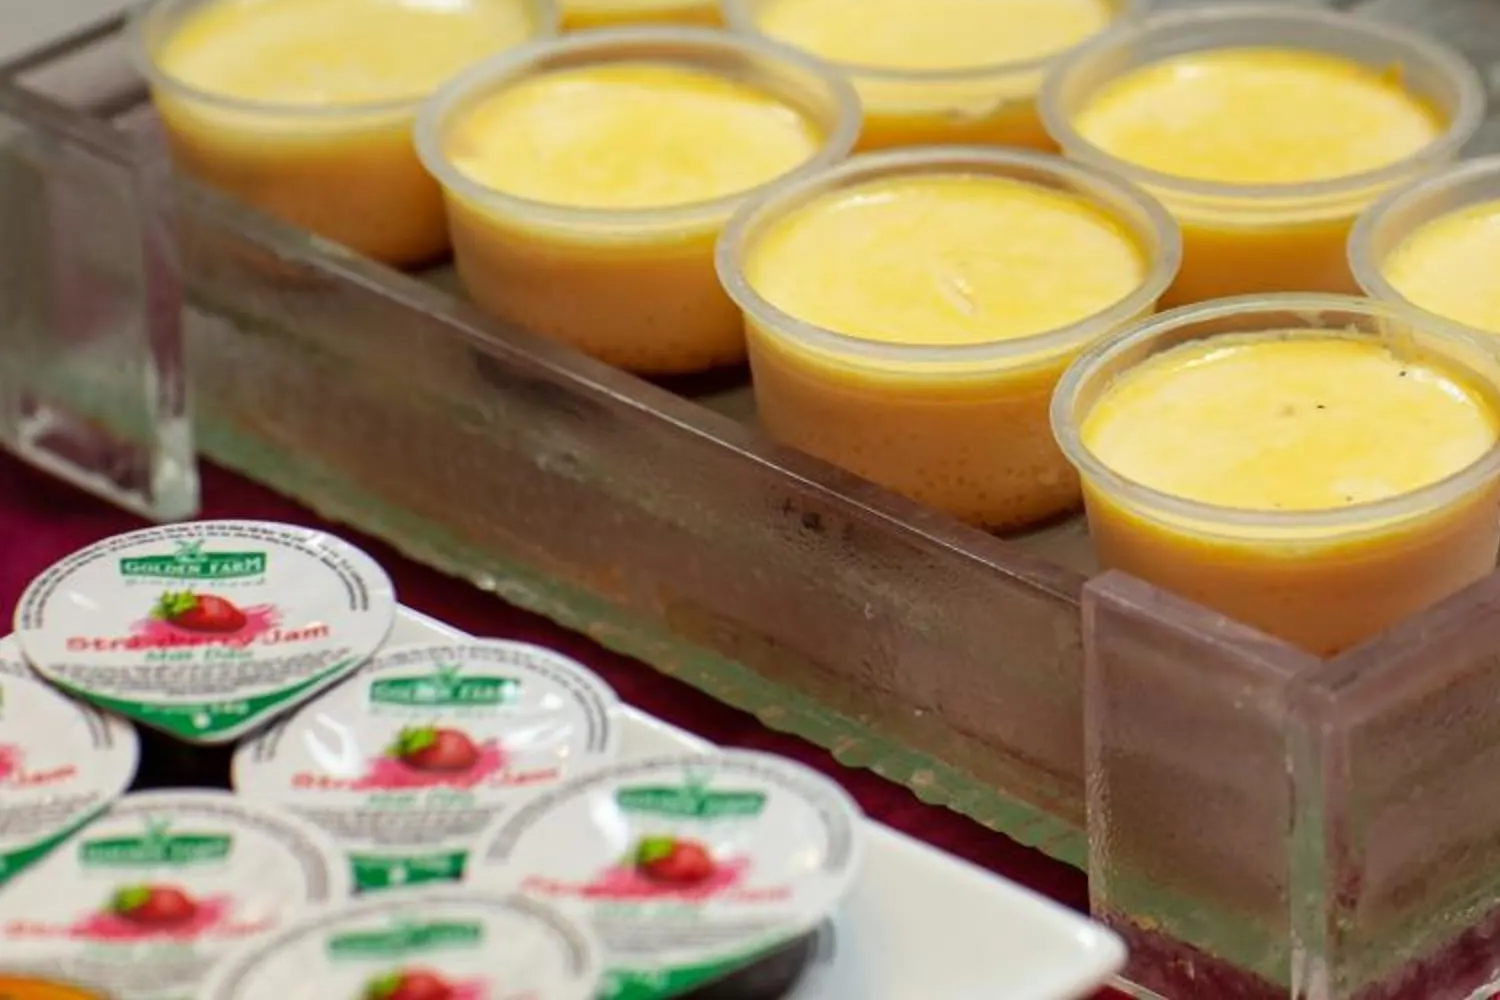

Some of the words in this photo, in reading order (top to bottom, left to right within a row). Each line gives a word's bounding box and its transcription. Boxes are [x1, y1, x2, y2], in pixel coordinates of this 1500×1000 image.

[124, 560, 200, 577] GOLDEN
[209, 556, 262, 574] FARM
[262, 625, 330, 645] Jam
